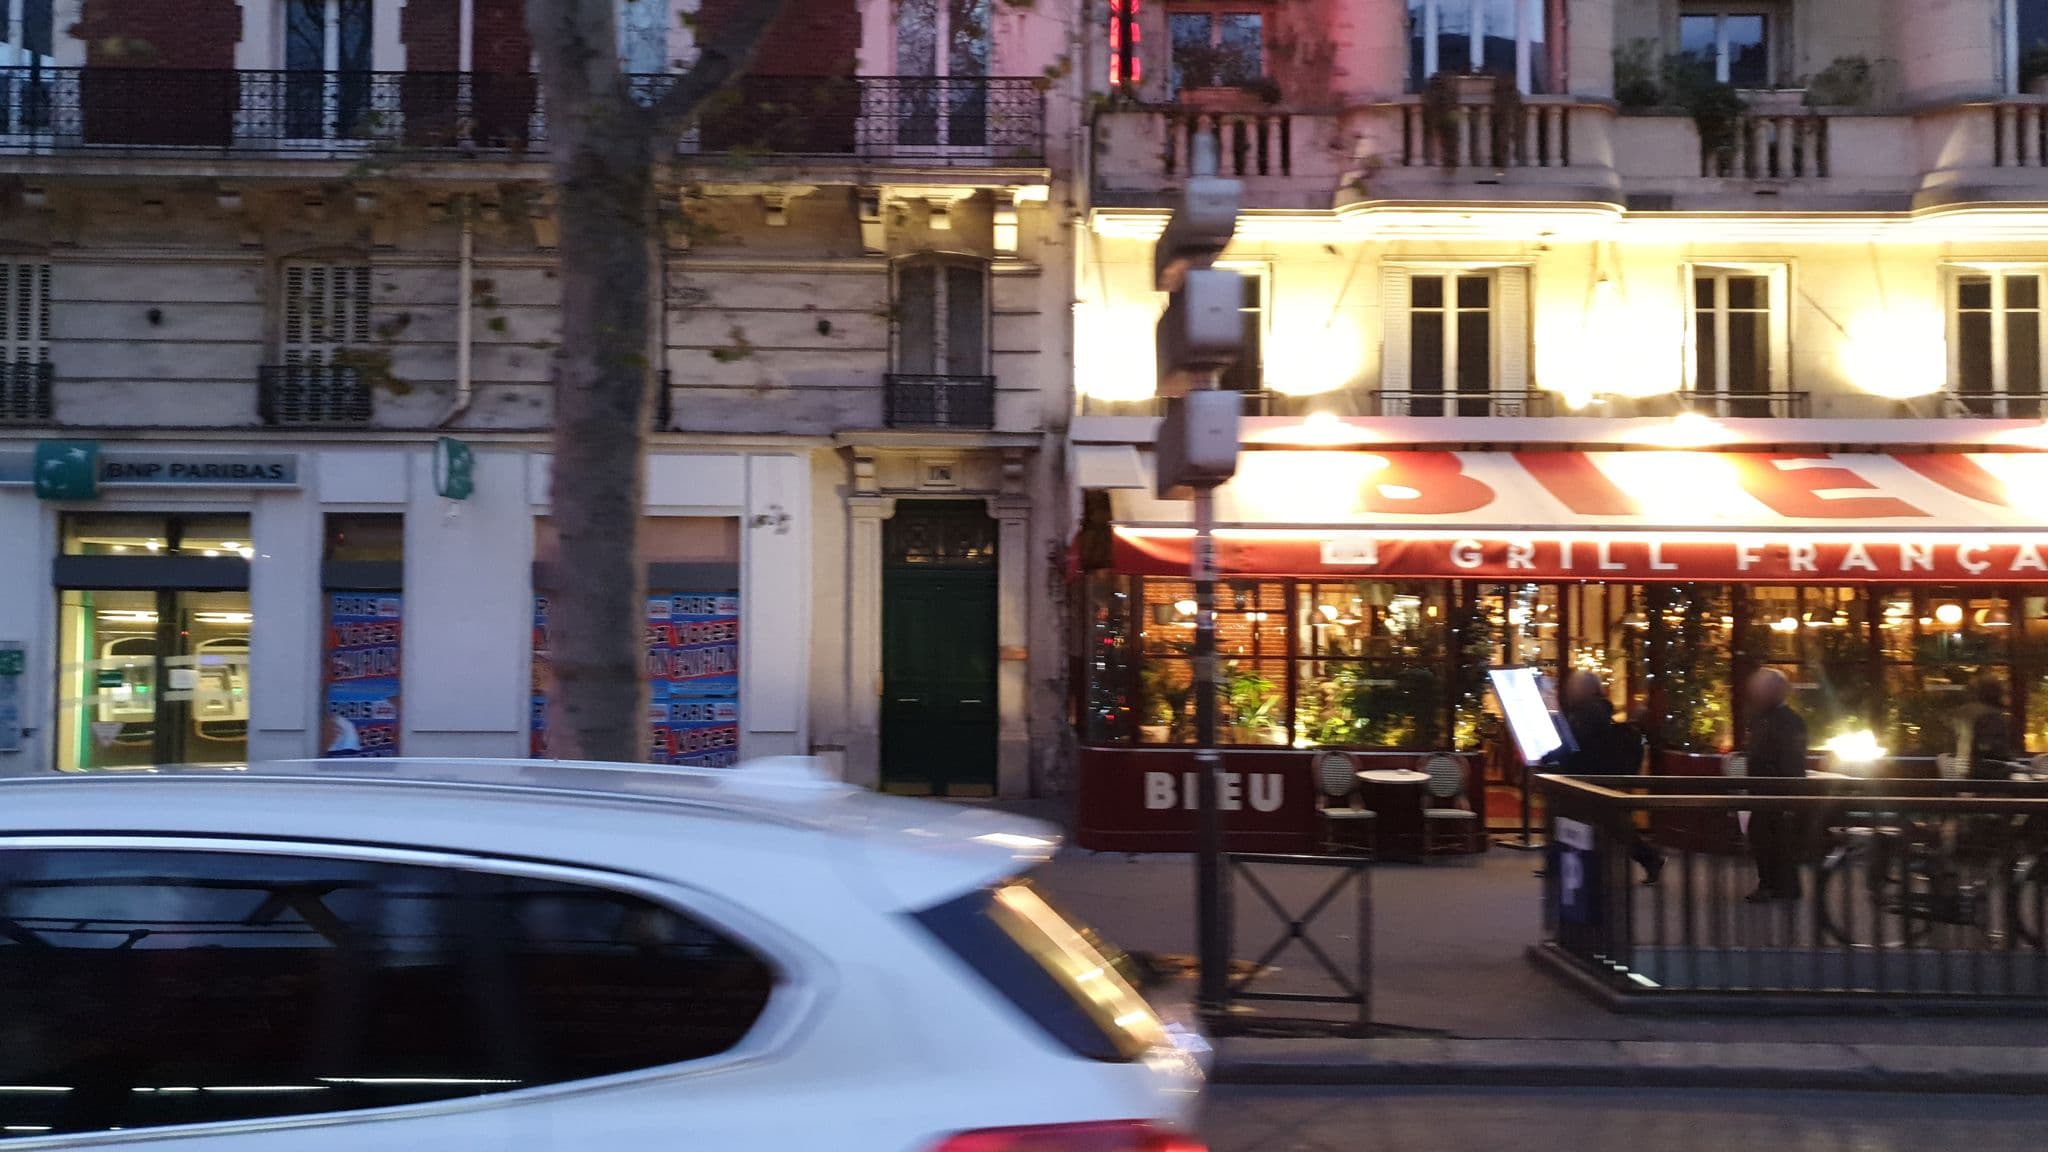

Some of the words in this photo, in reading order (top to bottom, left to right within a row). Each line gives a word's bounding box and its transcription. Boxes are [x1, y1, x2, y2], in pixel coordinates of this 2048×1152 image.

[108, 463, 161, 478] BNP
[168, 464, 284, 479] PARIBAS
[1449, 539, 1679, 570] GRILL
[1737, 541, 2048, 575] FRANÇA
[672, 596, 716, 615] PARIS
[672, 703, 715, 720] PARIS
